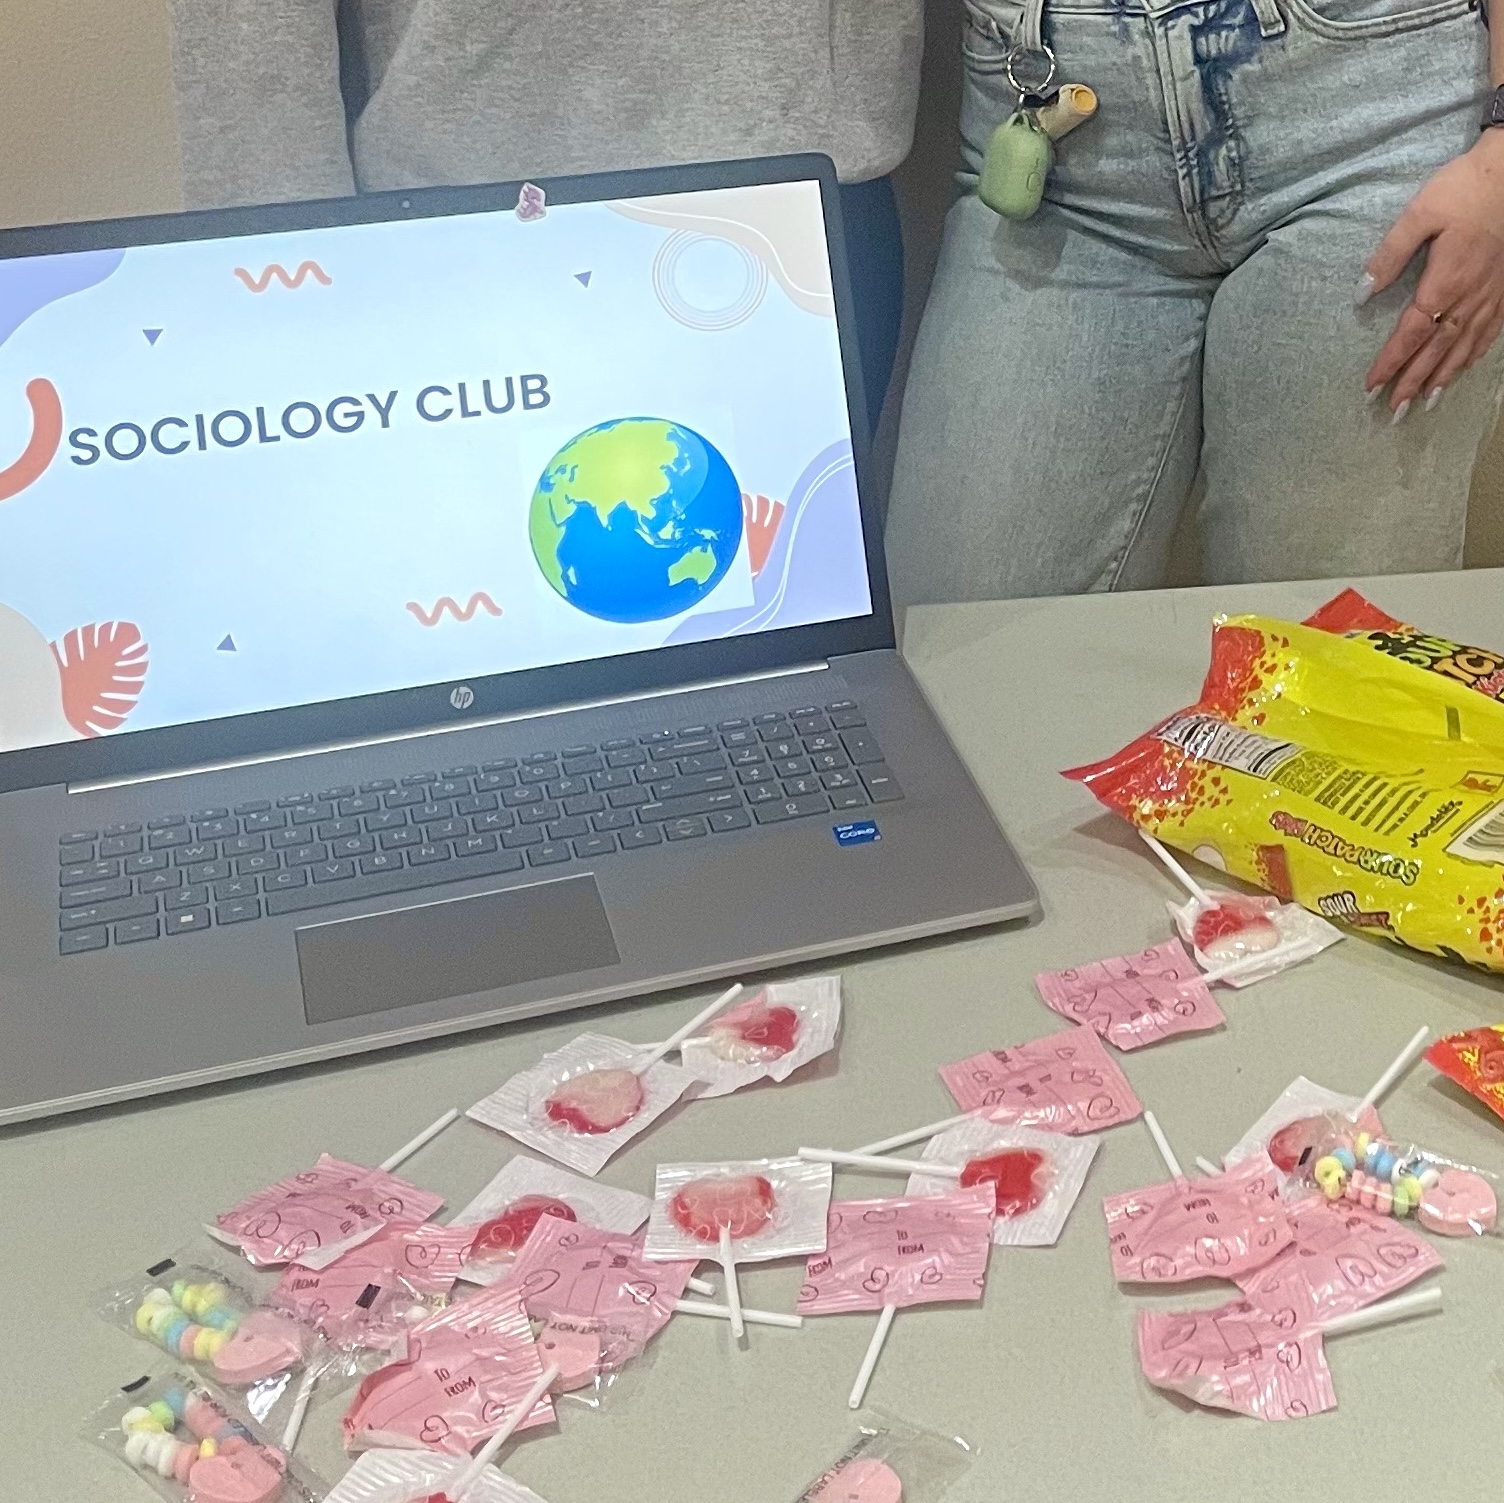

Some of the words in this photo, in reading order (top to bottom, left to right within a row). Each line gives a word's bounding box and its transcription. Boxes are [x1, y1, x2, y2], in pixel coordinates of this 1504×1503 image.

[68, 390, 400, 467] SOCIOLOGY
[415, 372, 553, 423] CLUB
[451, 686, 474, 709] hp
[1301, 822, 1365, 866] PATCH
[1318, 890, 1359, 918] SOUR
